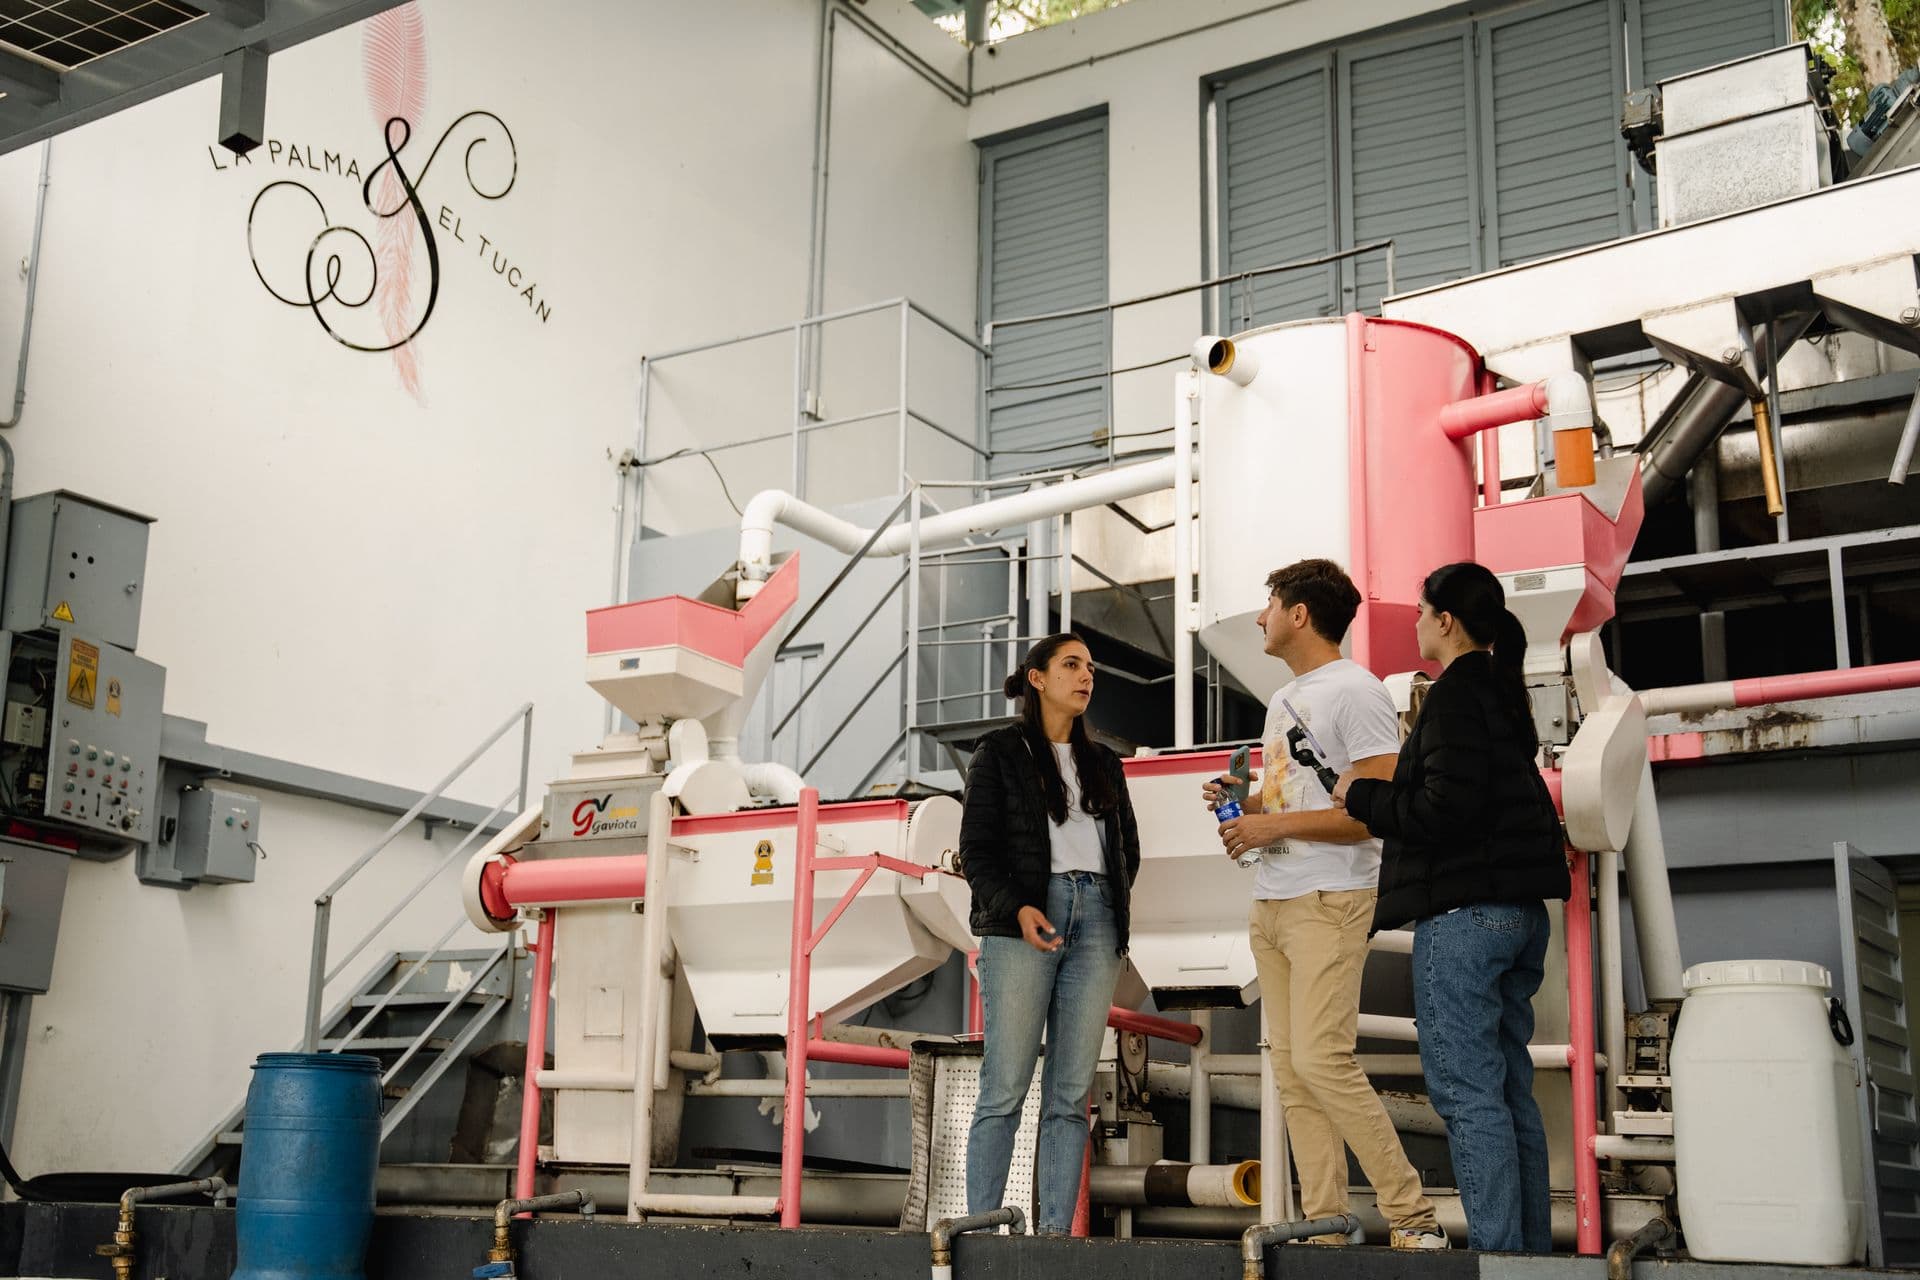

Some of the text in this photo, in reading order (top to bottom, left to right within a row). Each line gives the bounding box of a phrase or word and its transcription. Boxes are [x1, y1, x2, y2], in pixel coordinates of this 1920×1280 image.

[208, 139, 362, 183] LA PALMA
[438, 205, 552, 324] EL TUCÁN
[591, 819, 638, 836] Gaviota
